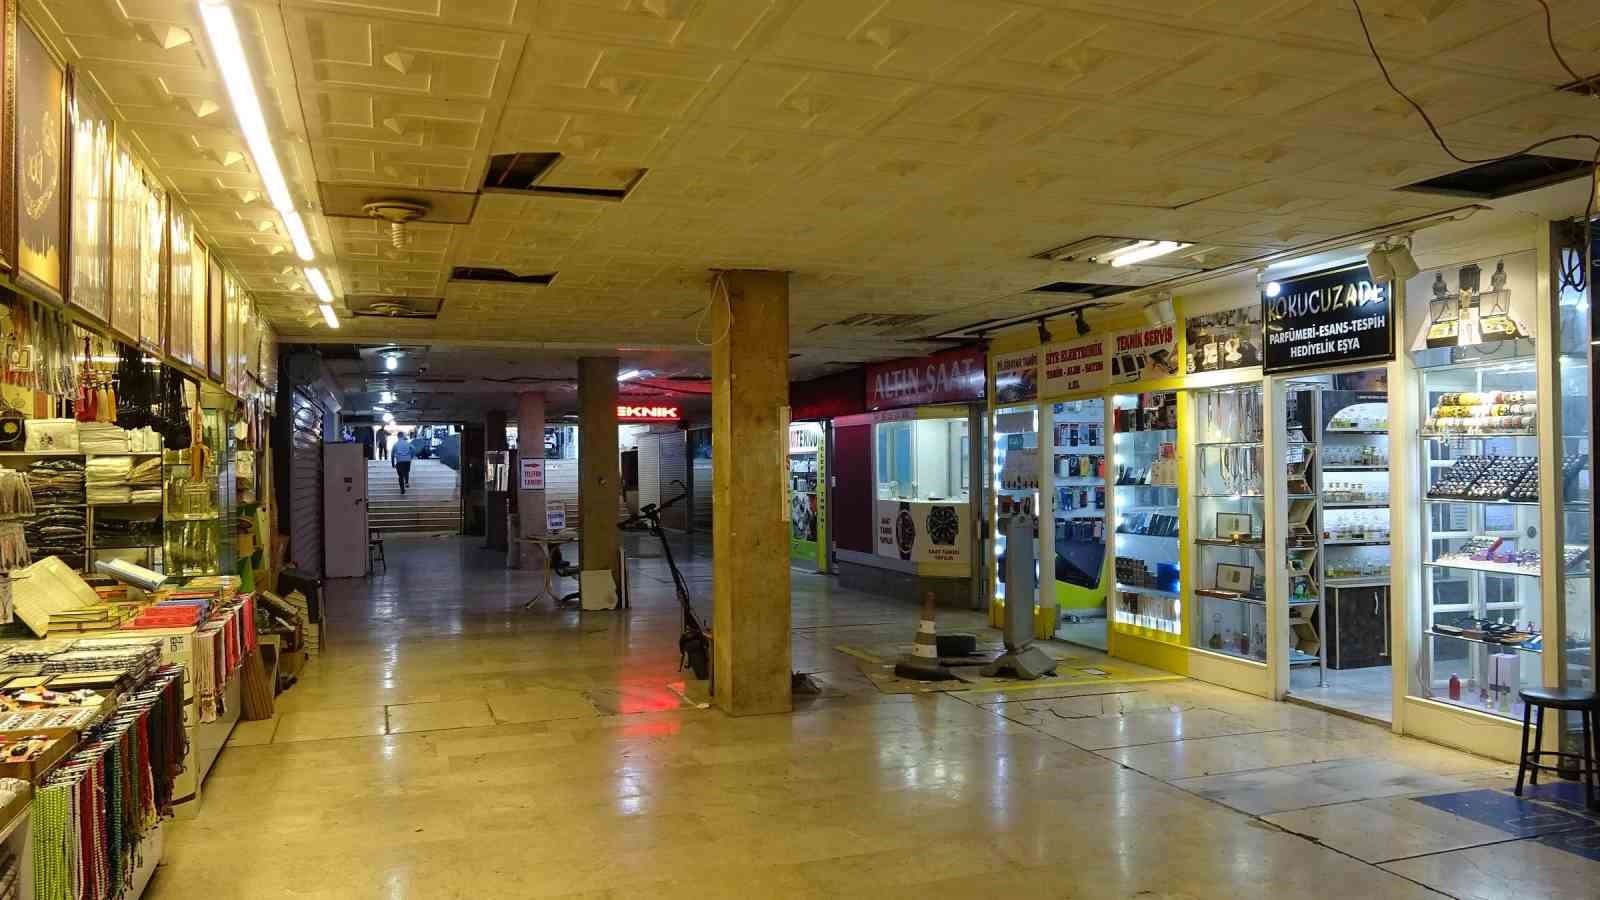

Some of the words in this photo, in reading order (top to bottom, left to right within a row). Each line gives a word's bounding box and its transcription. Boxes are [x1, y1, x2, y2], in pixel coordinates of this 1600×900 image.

[1267, 280, 1385, 322] KOKUCUZADE
[1269, 313, 1385, 345] PARFÜMERİ-ESANS-TESPİH
[1290, 339, 1335, 358] HEDİYELİK
[1337, 337, 1361, 354] EŞYA
[926, 358, 976, 393] SAAT
